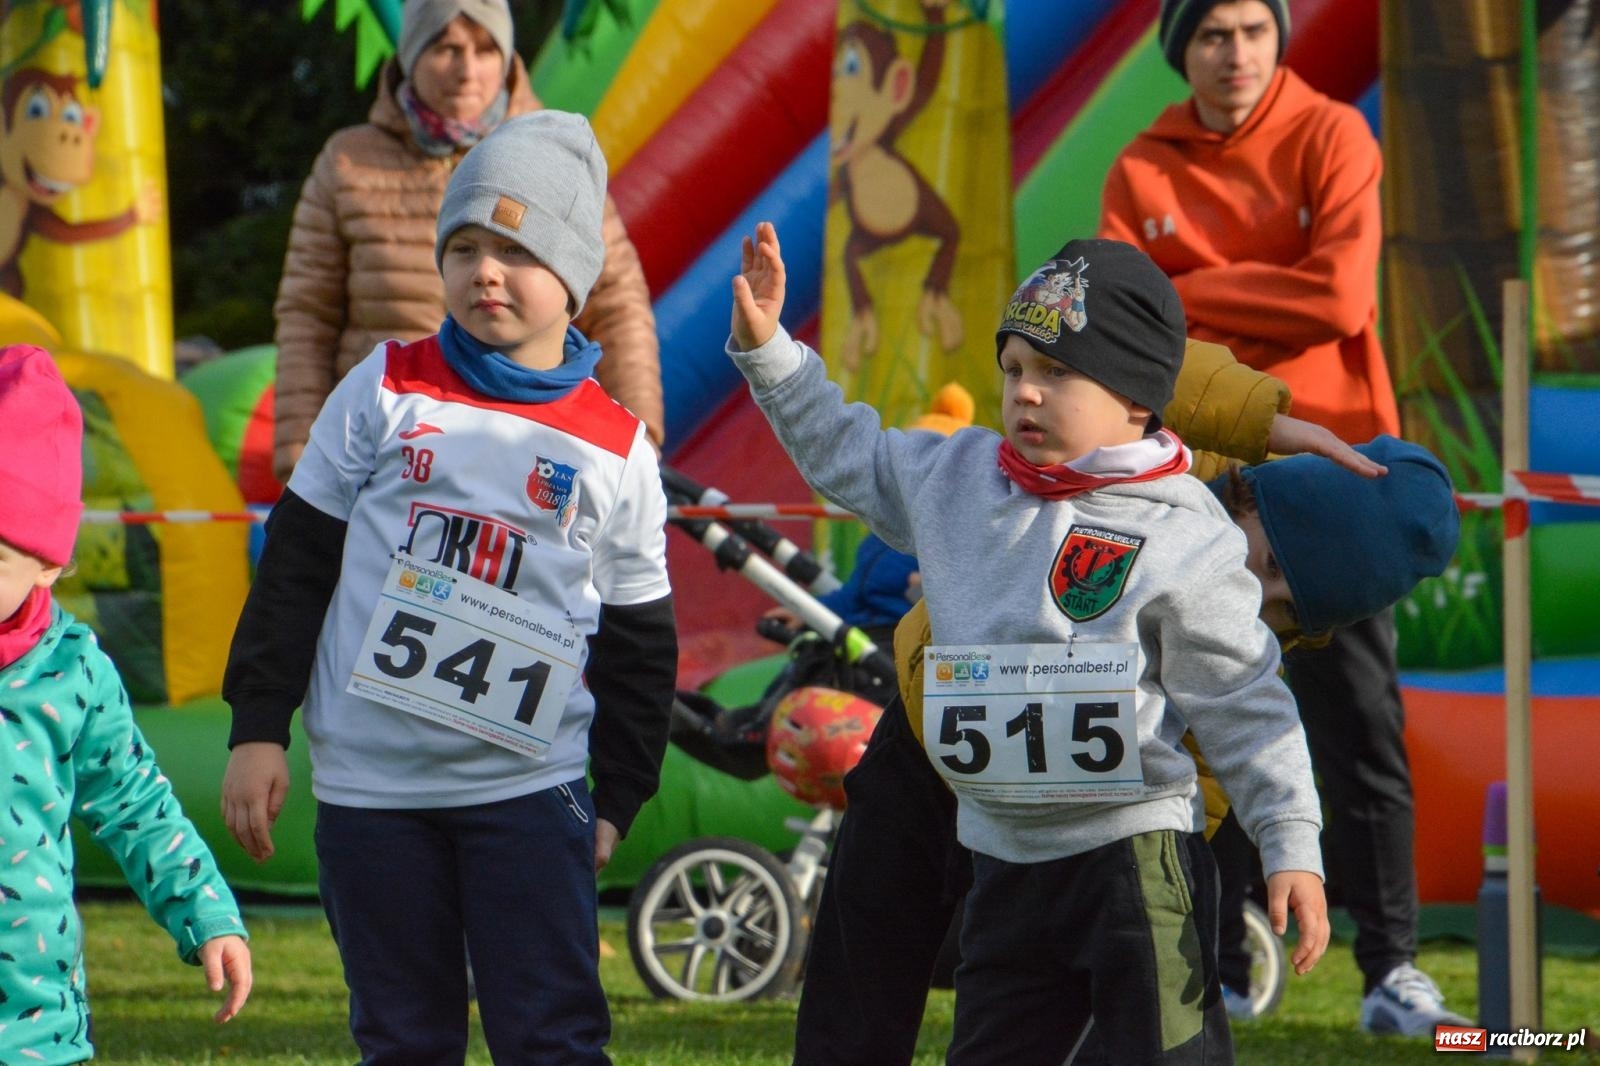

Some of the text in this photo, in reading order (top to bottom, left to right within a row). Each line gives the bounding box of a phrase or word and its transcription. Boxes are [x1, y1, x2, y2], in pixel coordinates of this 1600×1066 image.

[401, 446, 434, 483] 38
[535, 488, 560, 506] 1918
[1063, 592, 1099, 612] START
[460, 592, 575, 650] www.personalbest.pl
[373, 609, 552, 726] 541
[999, 661, 1128, 677] www.personalbest.pl
[939, 702, 1125, 775] 515
